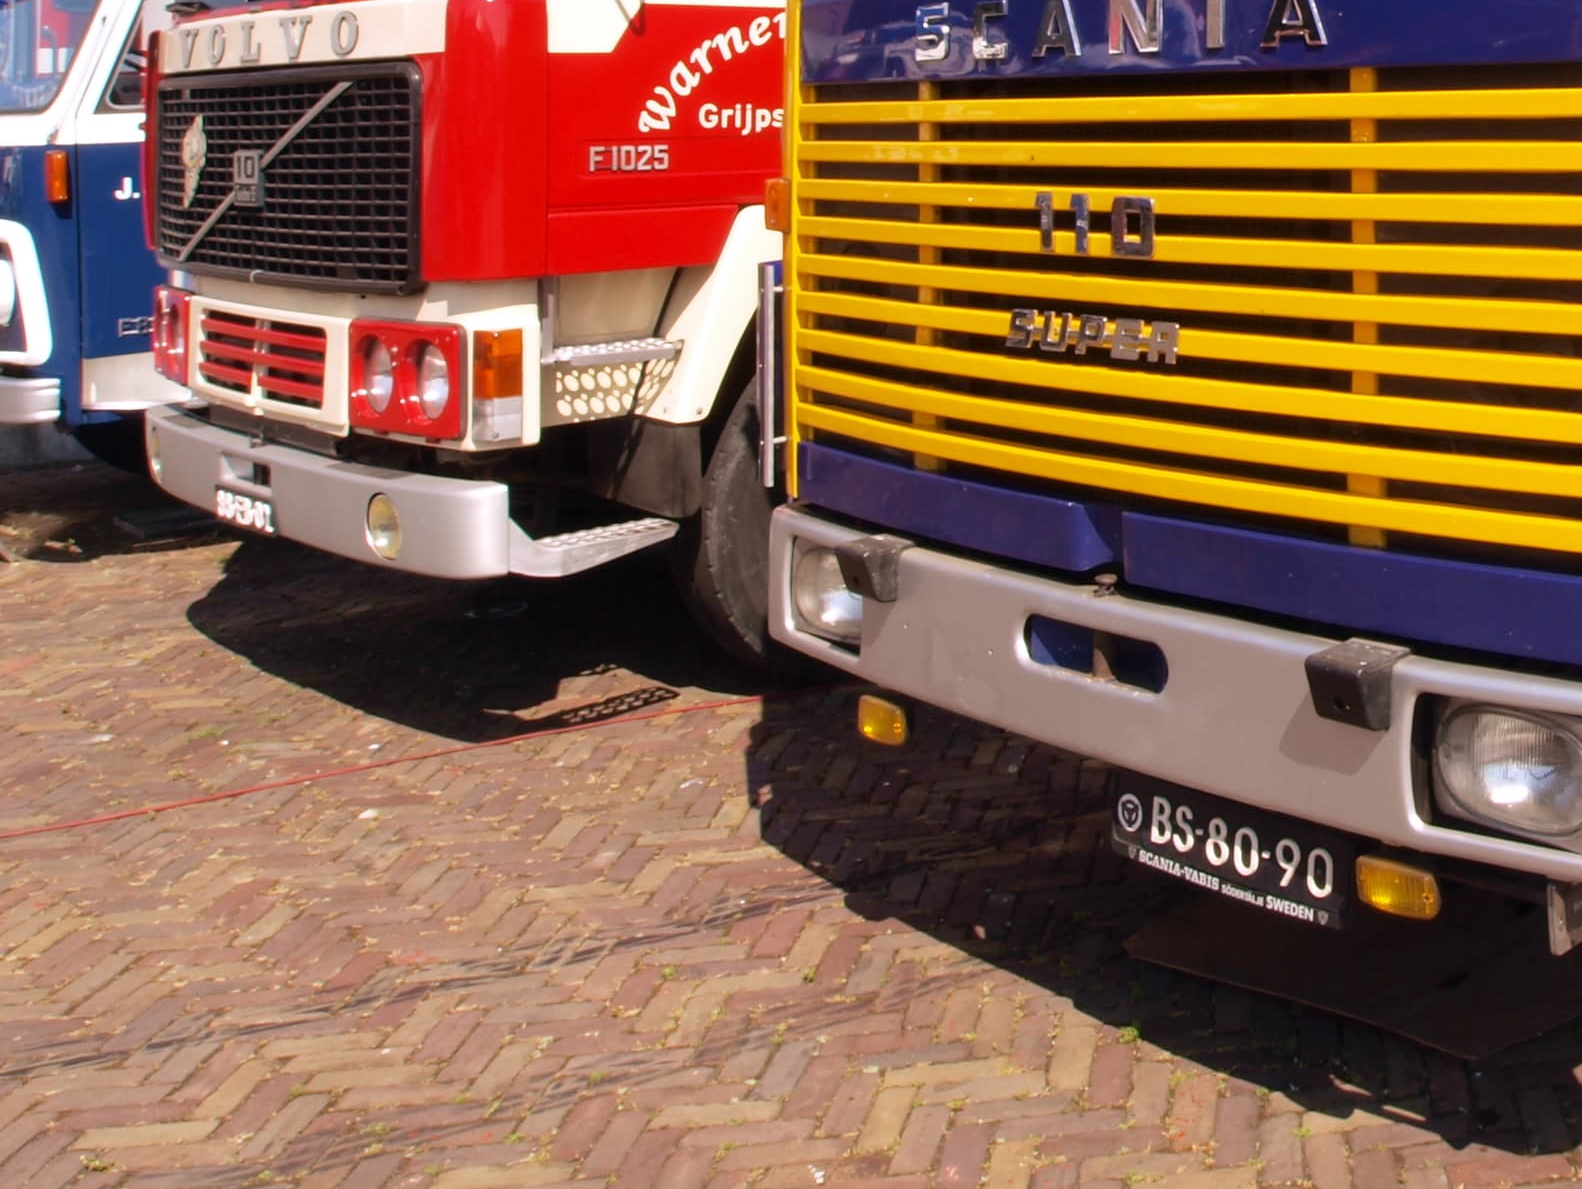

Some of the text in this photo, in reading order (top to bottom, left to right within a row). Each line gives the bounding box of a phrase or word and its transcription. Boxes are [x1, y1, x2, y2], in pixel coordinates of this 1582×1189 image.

[180, 10, 359, 69] VOLVO
[1034, 191, 1157, 260] 110
[1005, 308, 1180, 365] SUPER
[1150, 796, 1334, 899] BS-80-90
[1138, 849, 1220, 892] SCANIA-VABIS
[1265, 894, 1315, 922] SWEDEN
